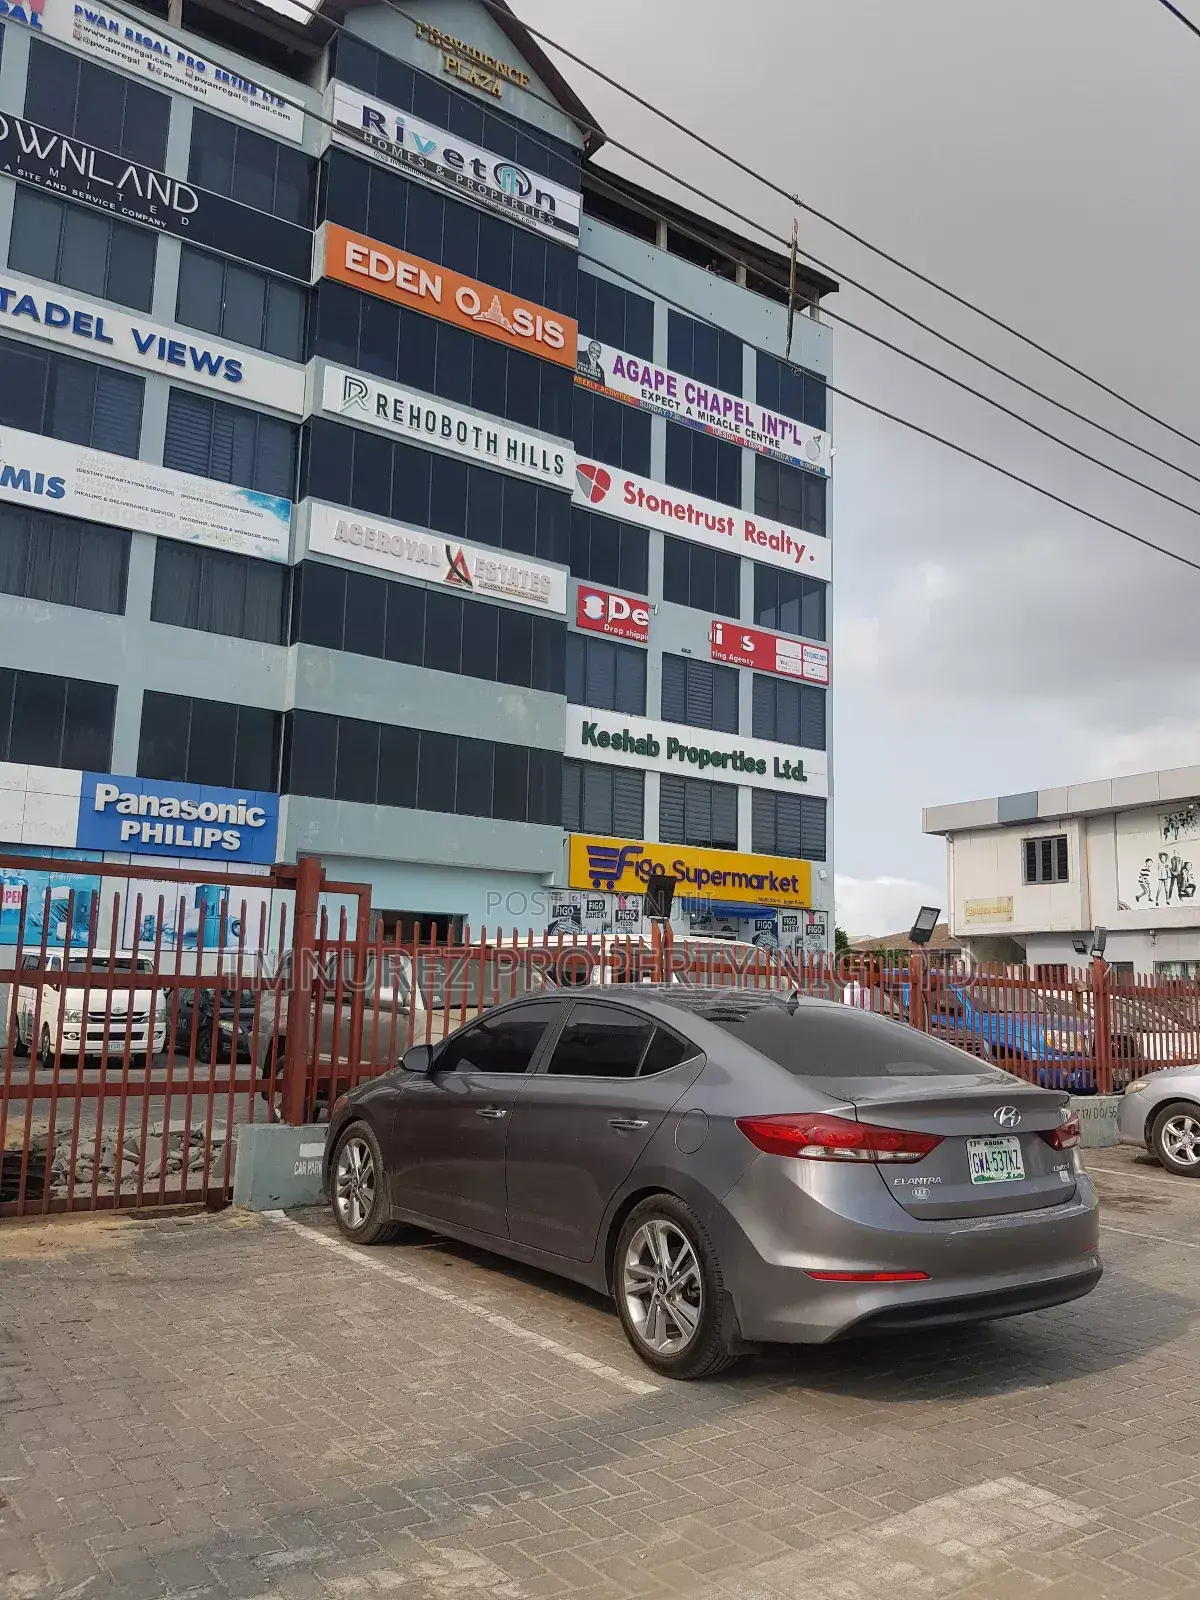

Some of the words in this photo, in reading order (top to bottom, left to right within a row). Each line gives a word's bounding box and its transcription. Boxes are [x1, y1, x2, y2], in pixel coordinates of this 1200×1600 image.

[74, 4, 119, 33] PWAN
[82, 36, 140, 65] @pwanregal
[83, 25, 172, 68] www.pwanregal.com
[443, 55, 502, 99] PLAZA
[363, 133, 425, 167] HOMES
[436, 165, 446, 177] &
[455, 174, 555, 226] PROPERTIES
[17, 169, 41, 183] SITE
[46, 179, 67, 192] AND
[72, 188, 116, 210] SERVICE
[121, 207, 167, 228] COMPANY
[345, 240, 442, 303] EDEN
[131, 327, 243, 383] VIEWS
[574, 375, 598, 390] WEEKLY
[612, 354, 677, 398] AGAPE
[684, 382, 755, 427] CHAPEL
[761, 412, 802, 446] INT'L
[375, 392, 498, 456] REHOBOTH
[505, 437, 564, 477] HILLS
[641, 388, 681, 411] EXPECT
[685, 407, 693, 416] A
[697, 410, 740, 433] MIRACLE
[745, 422, 780, 449] CENTRE
[0, 465, 66, 499] MIS
[105, 474, 145, 488] IMPARTATION
[109, 498, 149, 512] DELIVERANCE
[623, 480, 735, 536] Stonetrust
[474, 557, 551, 595] ESTATES
[604, 623, 624, 636] Drop
[728, 653, 754, 666] Agency
[581, 721, 660, 757] Keshab
[666, 737, 767, 774] Properties
[773, 757, 808, 782] Ltd.
[94, 783, 266, 828] Panasonic
[120, 820, 241, 851] PHILIPS
[616, 845, 666, 883] Figo
[672, 859, 799, 893] Supermarket
[556, 906, 574, 916] FIGO
[589, 902, 604, 910] FIGO
[618, 911, 636, 920] FIGO
[783, 917, 797, 925] FIGO
[757, 921, 773, 930] FIGO
[807, 926, 822, 934] FIGO
[893, 1176, 942, 1186] ELANTRA
